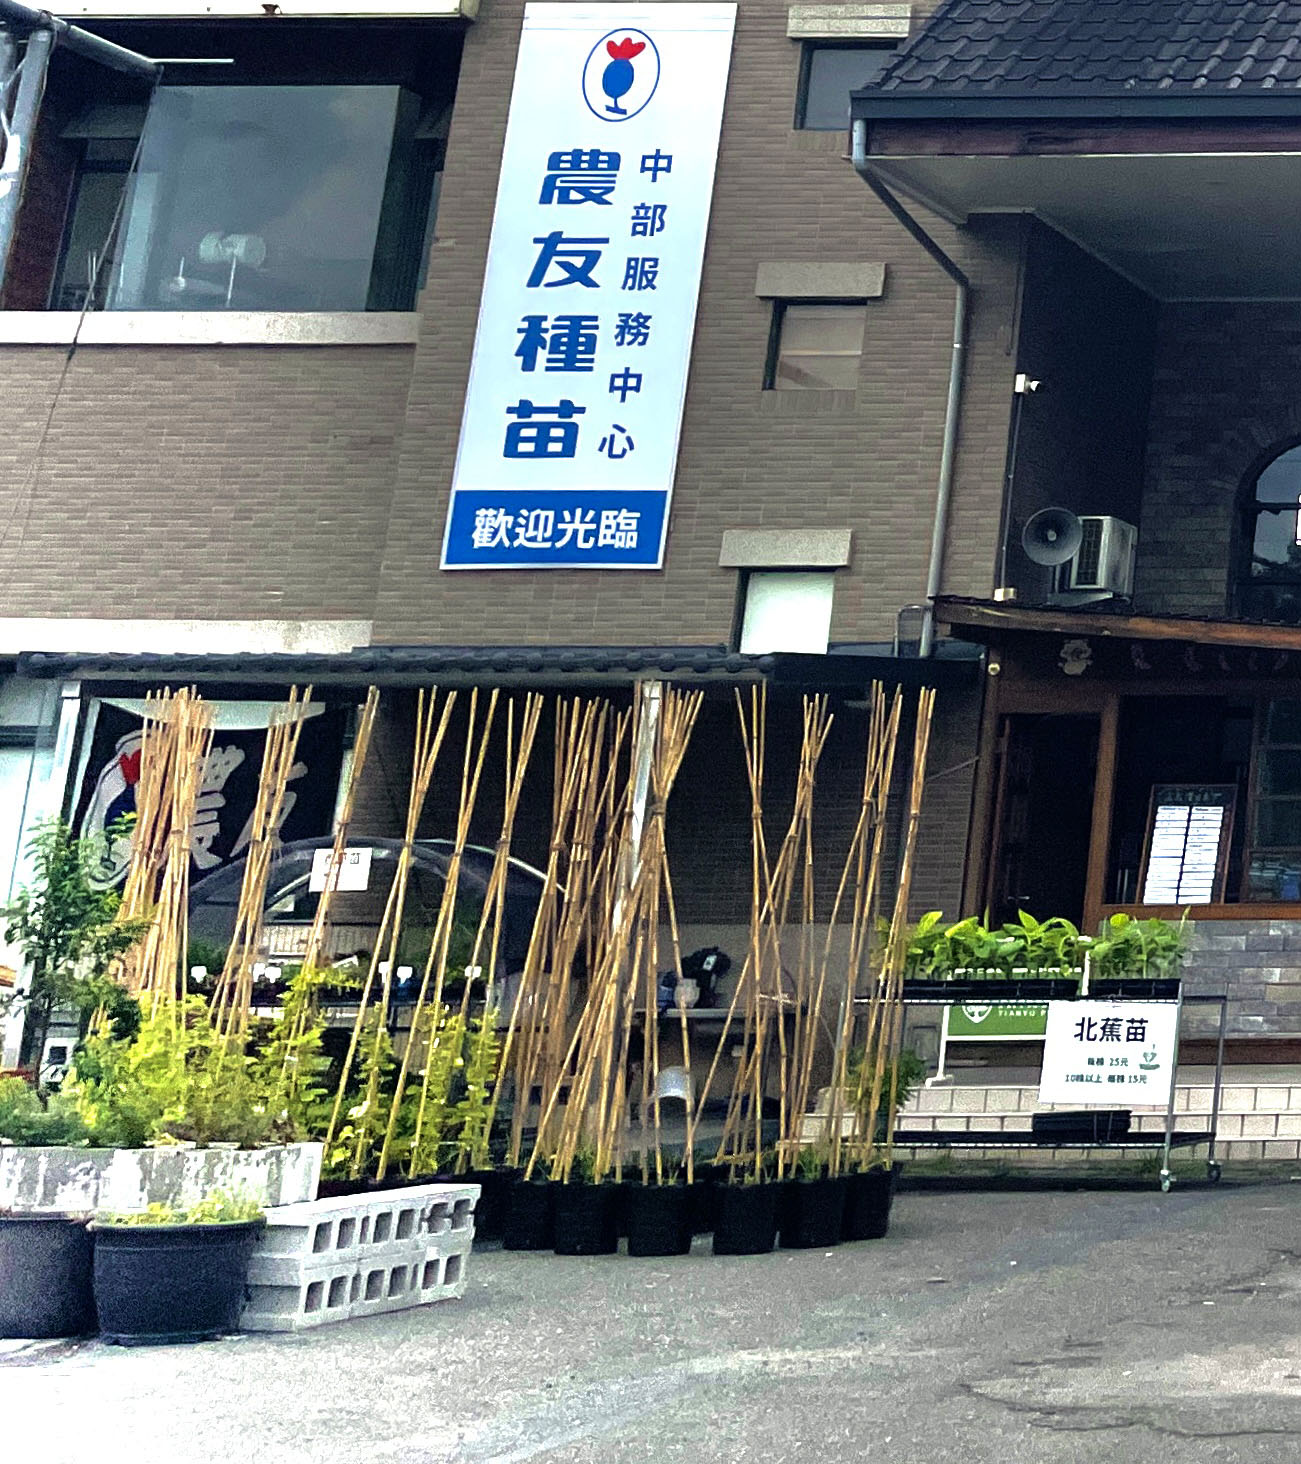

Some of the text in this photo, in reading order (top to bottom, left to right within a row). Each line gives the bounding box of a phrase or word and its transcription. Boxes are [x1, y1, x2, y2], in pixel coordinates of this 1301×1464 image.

[502, 147, 623, 461] 農友種苗
[597, 148, 674, 461] 中部服務中心
[471, 508, 640, 551] 歡迎光臨
[1073, 1017, 1149, 1043] 北蕉苗
